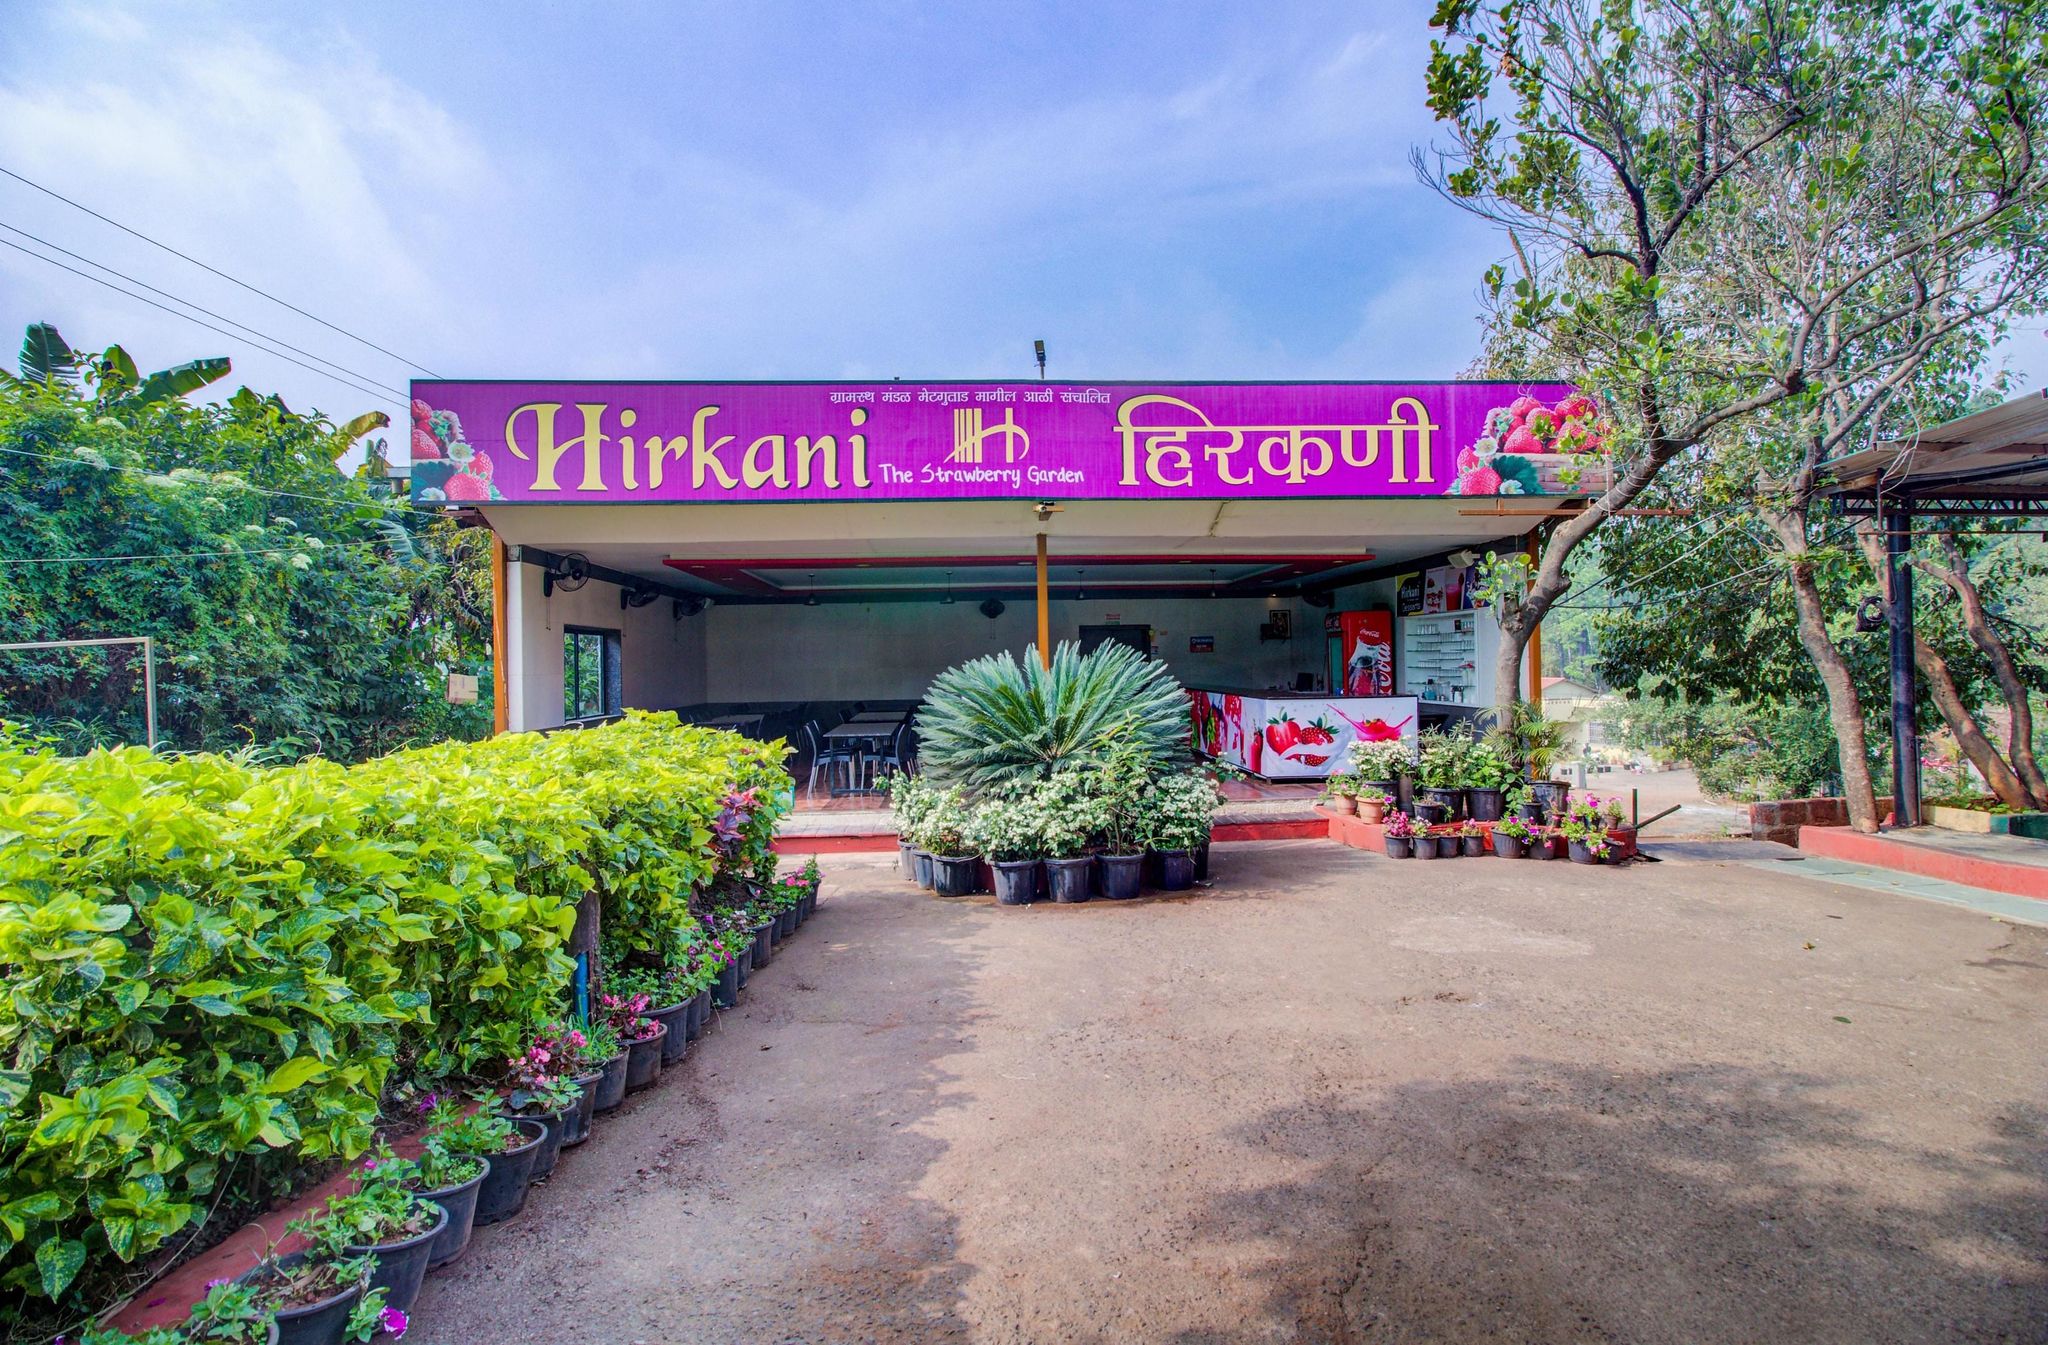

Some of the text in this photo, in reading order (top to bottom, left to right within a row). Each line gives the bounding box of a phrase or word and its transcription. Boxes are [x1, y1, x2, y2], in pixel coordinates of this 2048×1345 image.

[830, 388, 1111, 406] ग्रामस्थ मंडळ मेटगुताड मागील आळी संचालित
[505, 402, 872, 491] Hirkani
[1113, 395, 1439, 486] हिरकणी
[879, 463, 1085, 488] The Strawberry Garden
